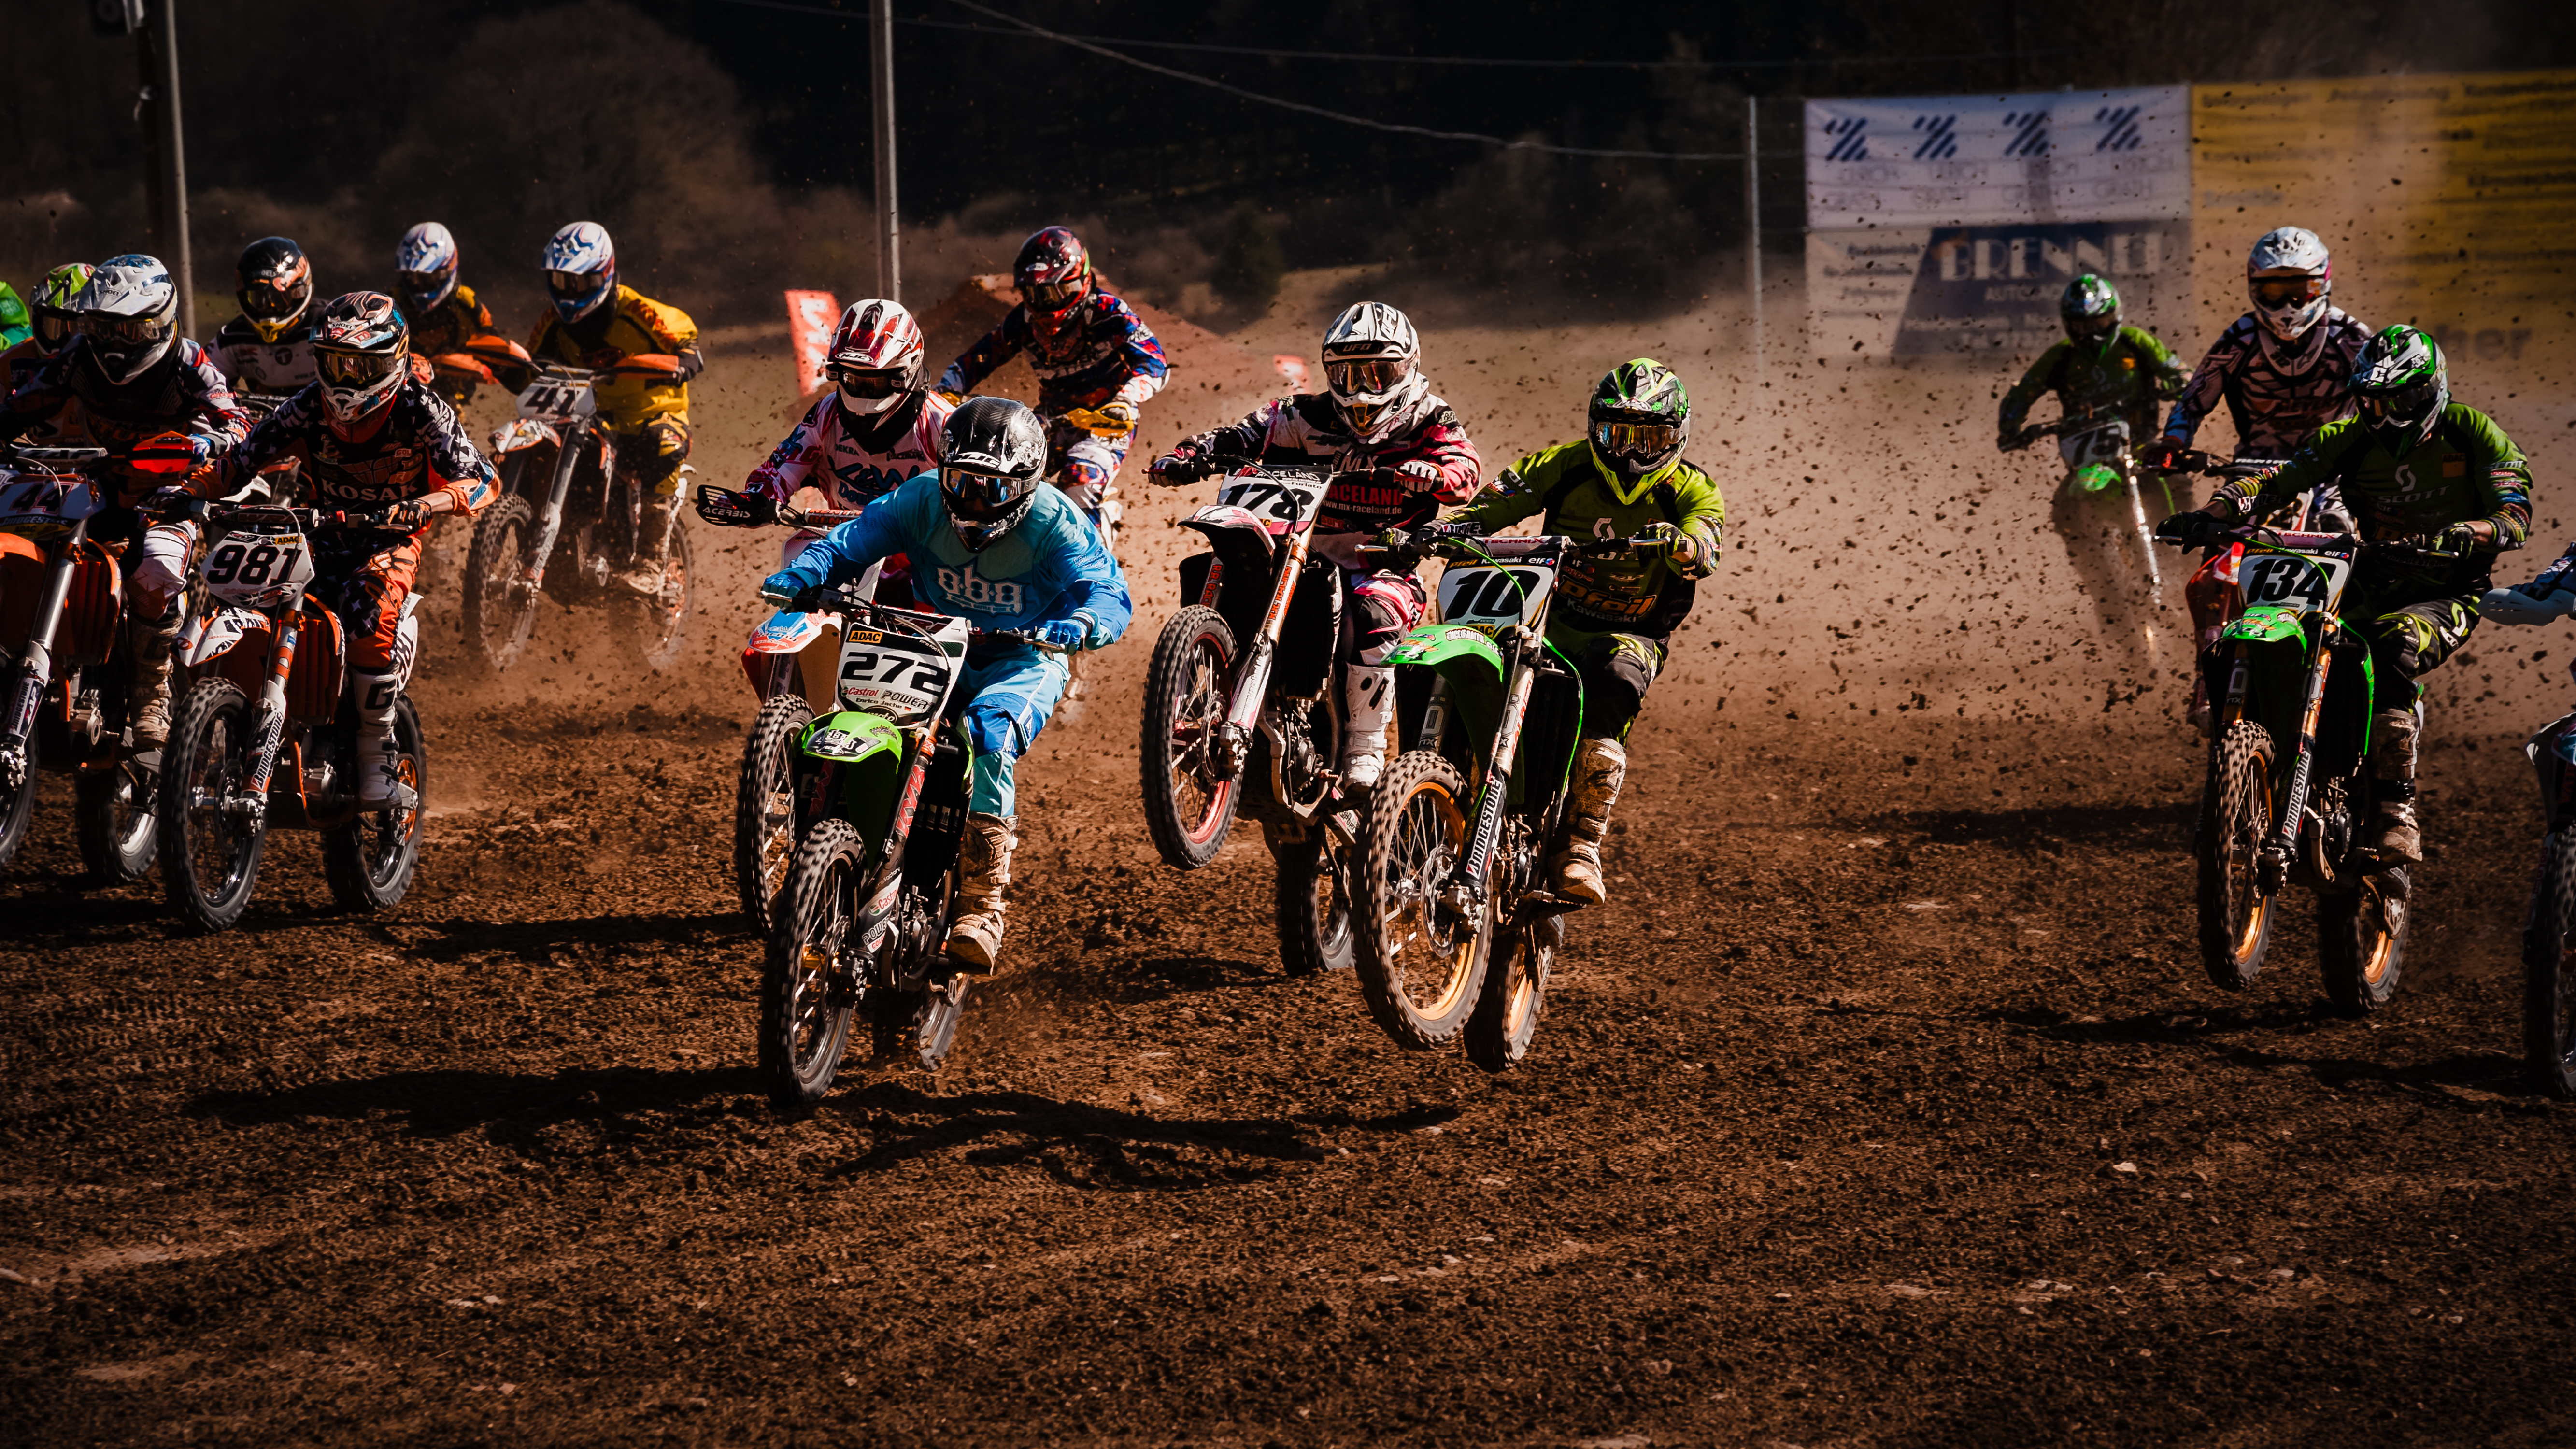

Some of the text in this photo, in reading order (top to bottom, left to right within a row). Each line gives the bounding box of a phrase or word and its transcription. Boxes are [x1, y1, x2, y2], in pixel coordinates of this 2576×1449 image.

[1342, 343, 1371, 352] UFO
[526, 387, 580, 414] 41
[836, 443, 860, 456] DEKRA
[1255, 470, 1321, 481] RACELAND
[9, 482, 75, 514] 44
[321, 478, 418, 503] KOSAK
[1224, 483, 1315, 521] 178
[1325, 484, 1404, 506] ACELAND
[2377, 485, 2451, 504] SCOTT
[237, 513, 307, 524] WRP
[702, 506, 751, 518] ACERBIS
[206, 545, 302, 587] 981
[1449, 559, 1478, 568] pfeil
[2247, 558, 2337, 606] 134
[1445, 570, 1540, 622] 10
[1558, 579, 1655, 616] pfeil
[1567, 597, 1637, 623] Kawasaki
[851, 632, 881, 642] ADAC
[841, 652, 950, 699] 272
[848, 687, 880, 697] Castrol
[880, 700, 902, 709] Jache
[12, 681, 30, 731] BRIDGESTONE
[254, 710, 285, 789] BRIDGESTONE
[2283, 750, 2311, 840] BRIDGESTONE
[1466, 779, 1502, 880] BRIDGESTONE
